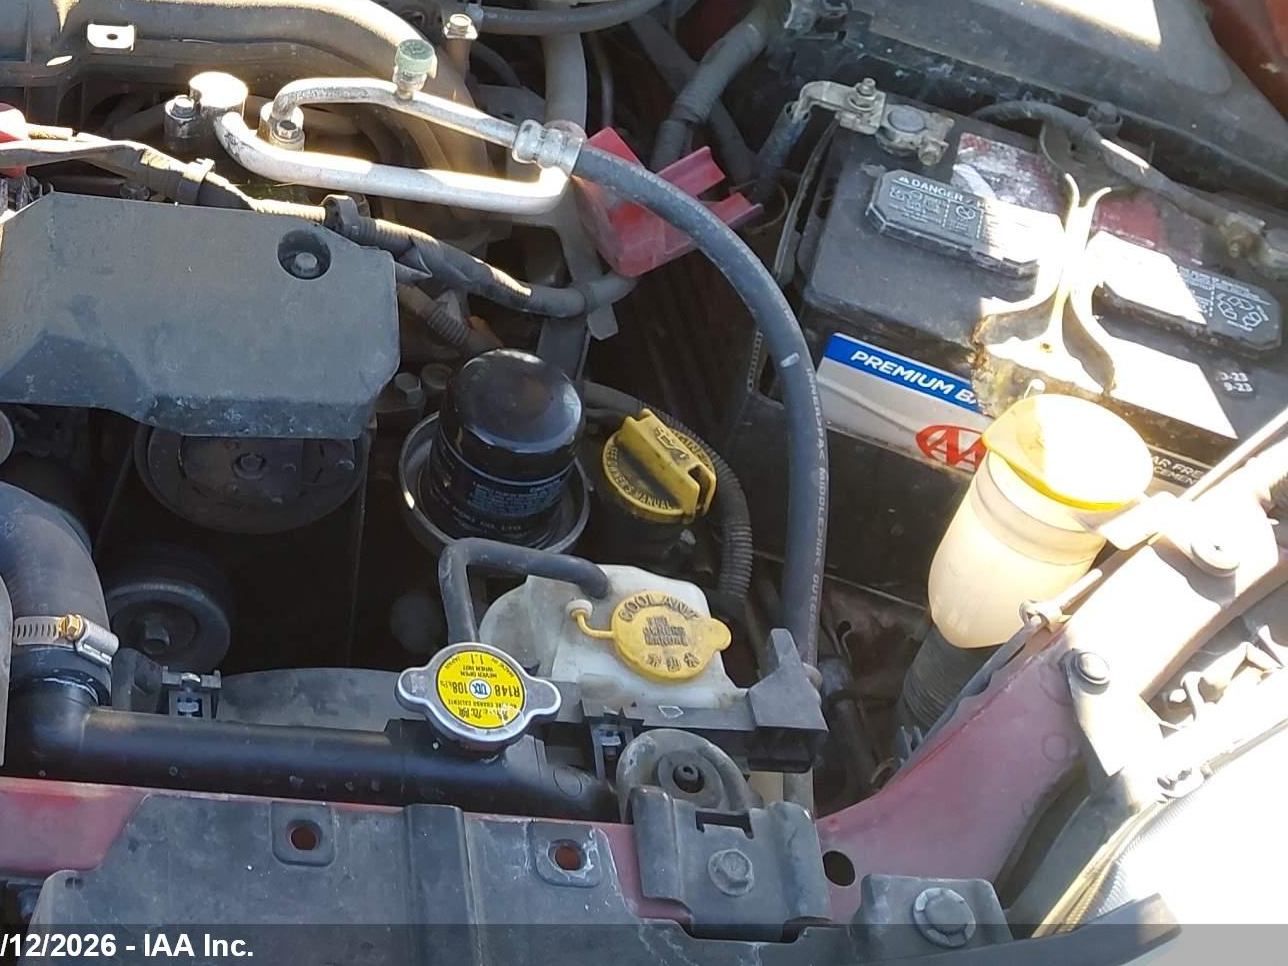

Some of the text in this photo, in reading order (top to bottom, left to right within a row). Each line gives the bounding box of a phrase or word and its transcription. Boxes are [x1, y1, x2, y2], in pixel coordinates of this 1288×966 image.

[911, 178, 963, 201] DANGER
[850, 350, 955, 395] PREMIUM
[916, 425, 987, 472] AA
[1152, 455, 1204, 479] AR FRE
[1153, 465, 1197, 485] CEMEN
[634, 490, 673, 510] MANUAL
[618, 593, 700, 622] COOLANT
[470, 654, 484, 665] 1.1
[460, 670, 498, 679] NEVER OPEN
[494, 684, 520, 697] R148
